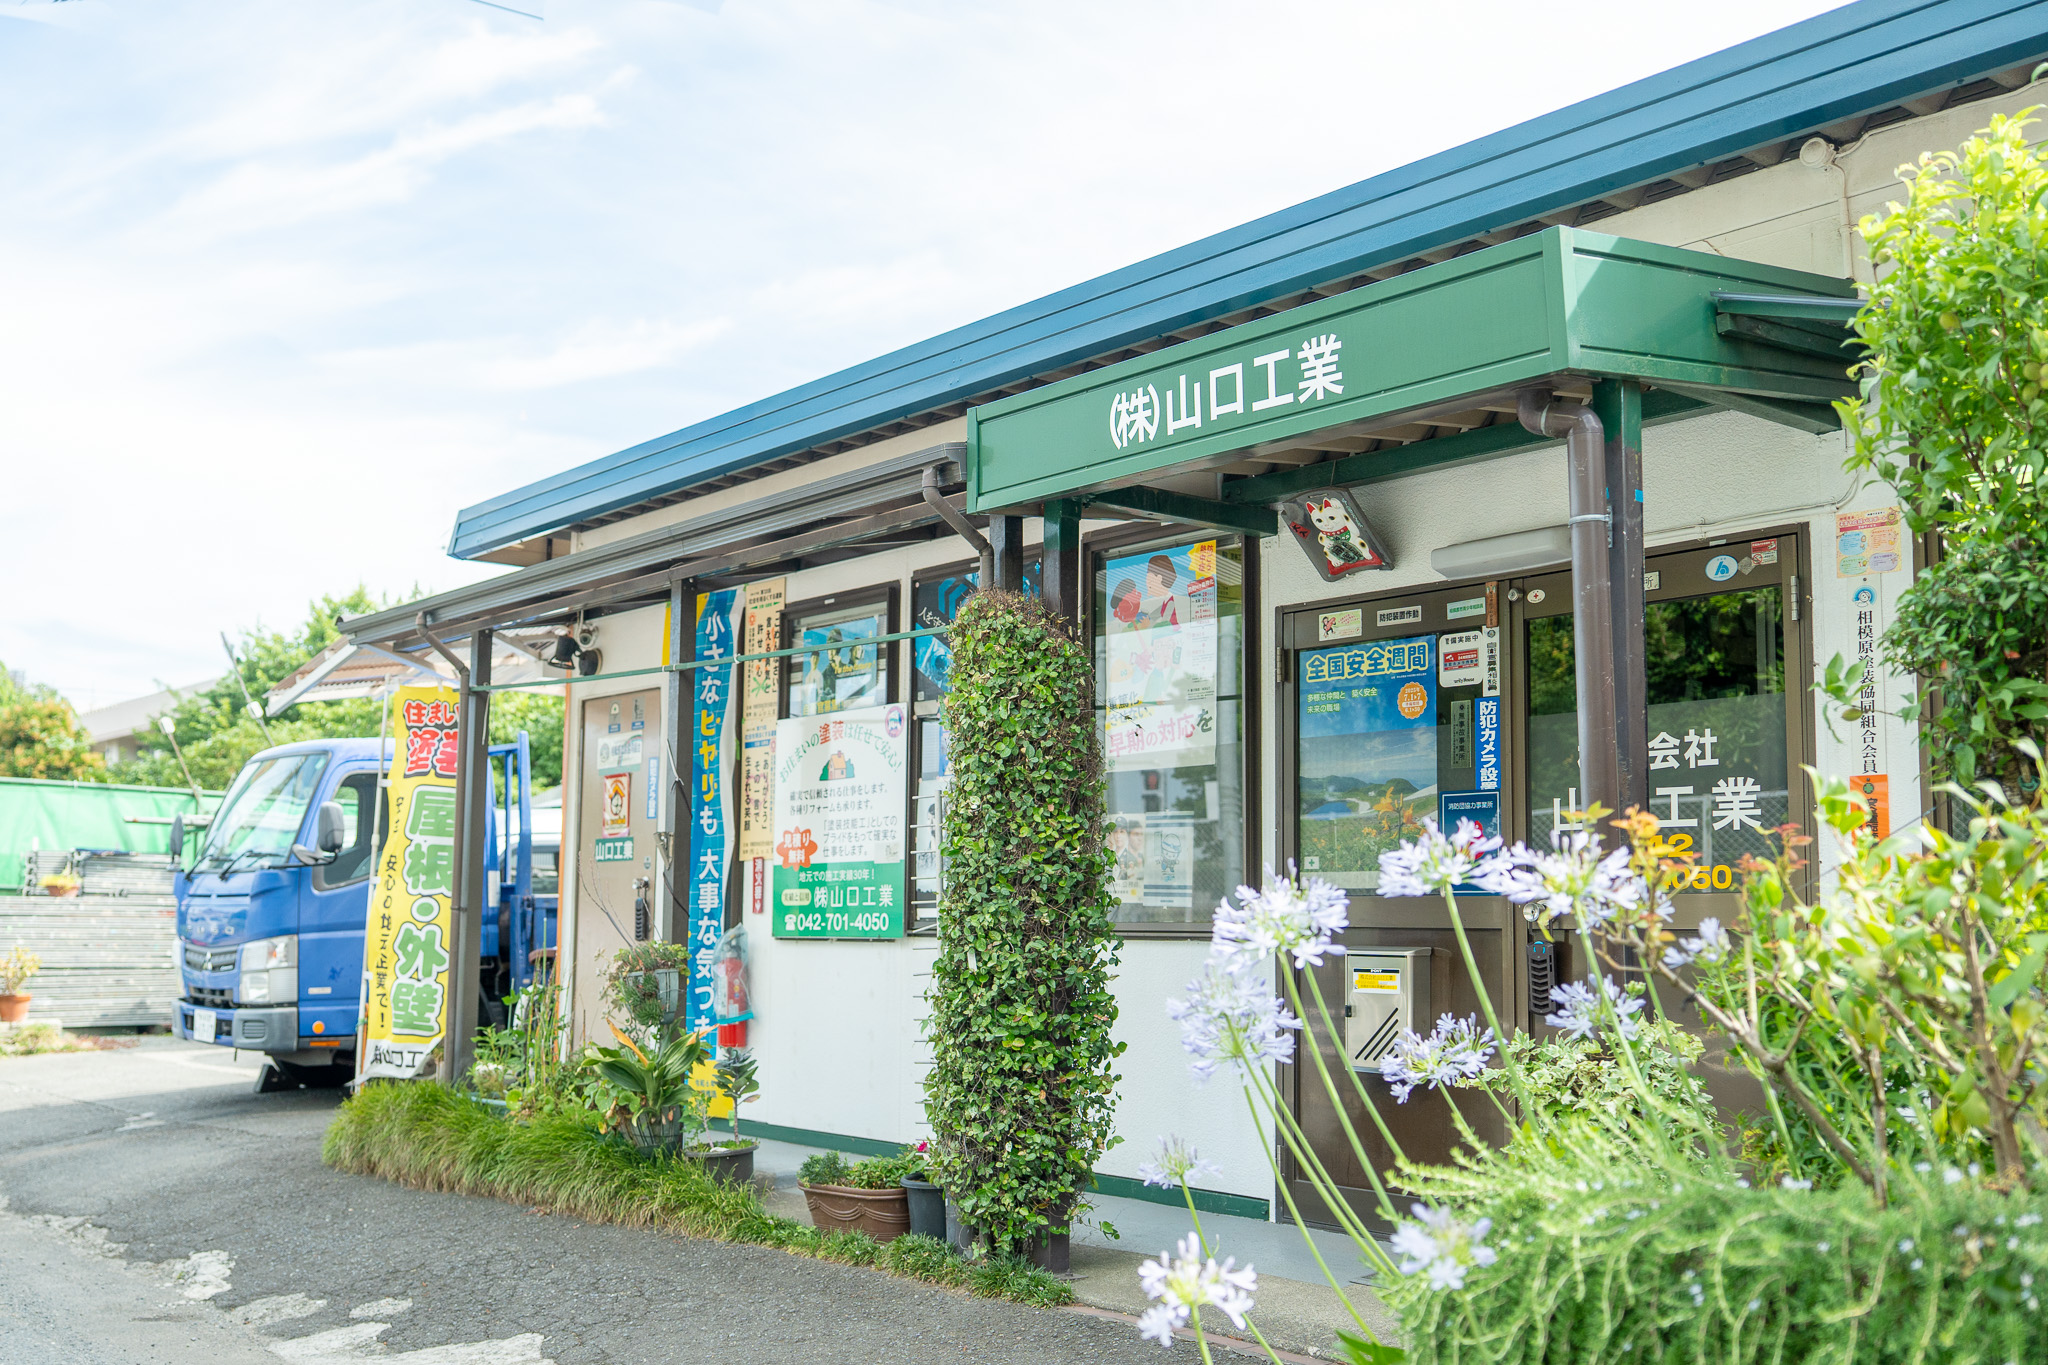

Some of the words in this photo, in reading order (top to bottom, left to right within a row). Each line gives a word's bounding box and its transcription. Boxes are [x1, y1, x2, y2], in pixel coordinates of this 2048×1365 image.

[1109, 333, 1345, 450] (株)山口工業
[1379, 609, 1420, 623] 防犯装置作動
[1306, 642, 1429, 683] 全国安全週間
[404, 700, 459, 724] 住まい
[699, 610, 726, 836] 小さなヒヤリも
[1108, 708, 1213, 758] 早期の対応を
[595, 840, 634, 861] 山口工業
[814, 884, 894, 908] (株)山口工業
[797, 912, 890, 932] 042-701-4050
